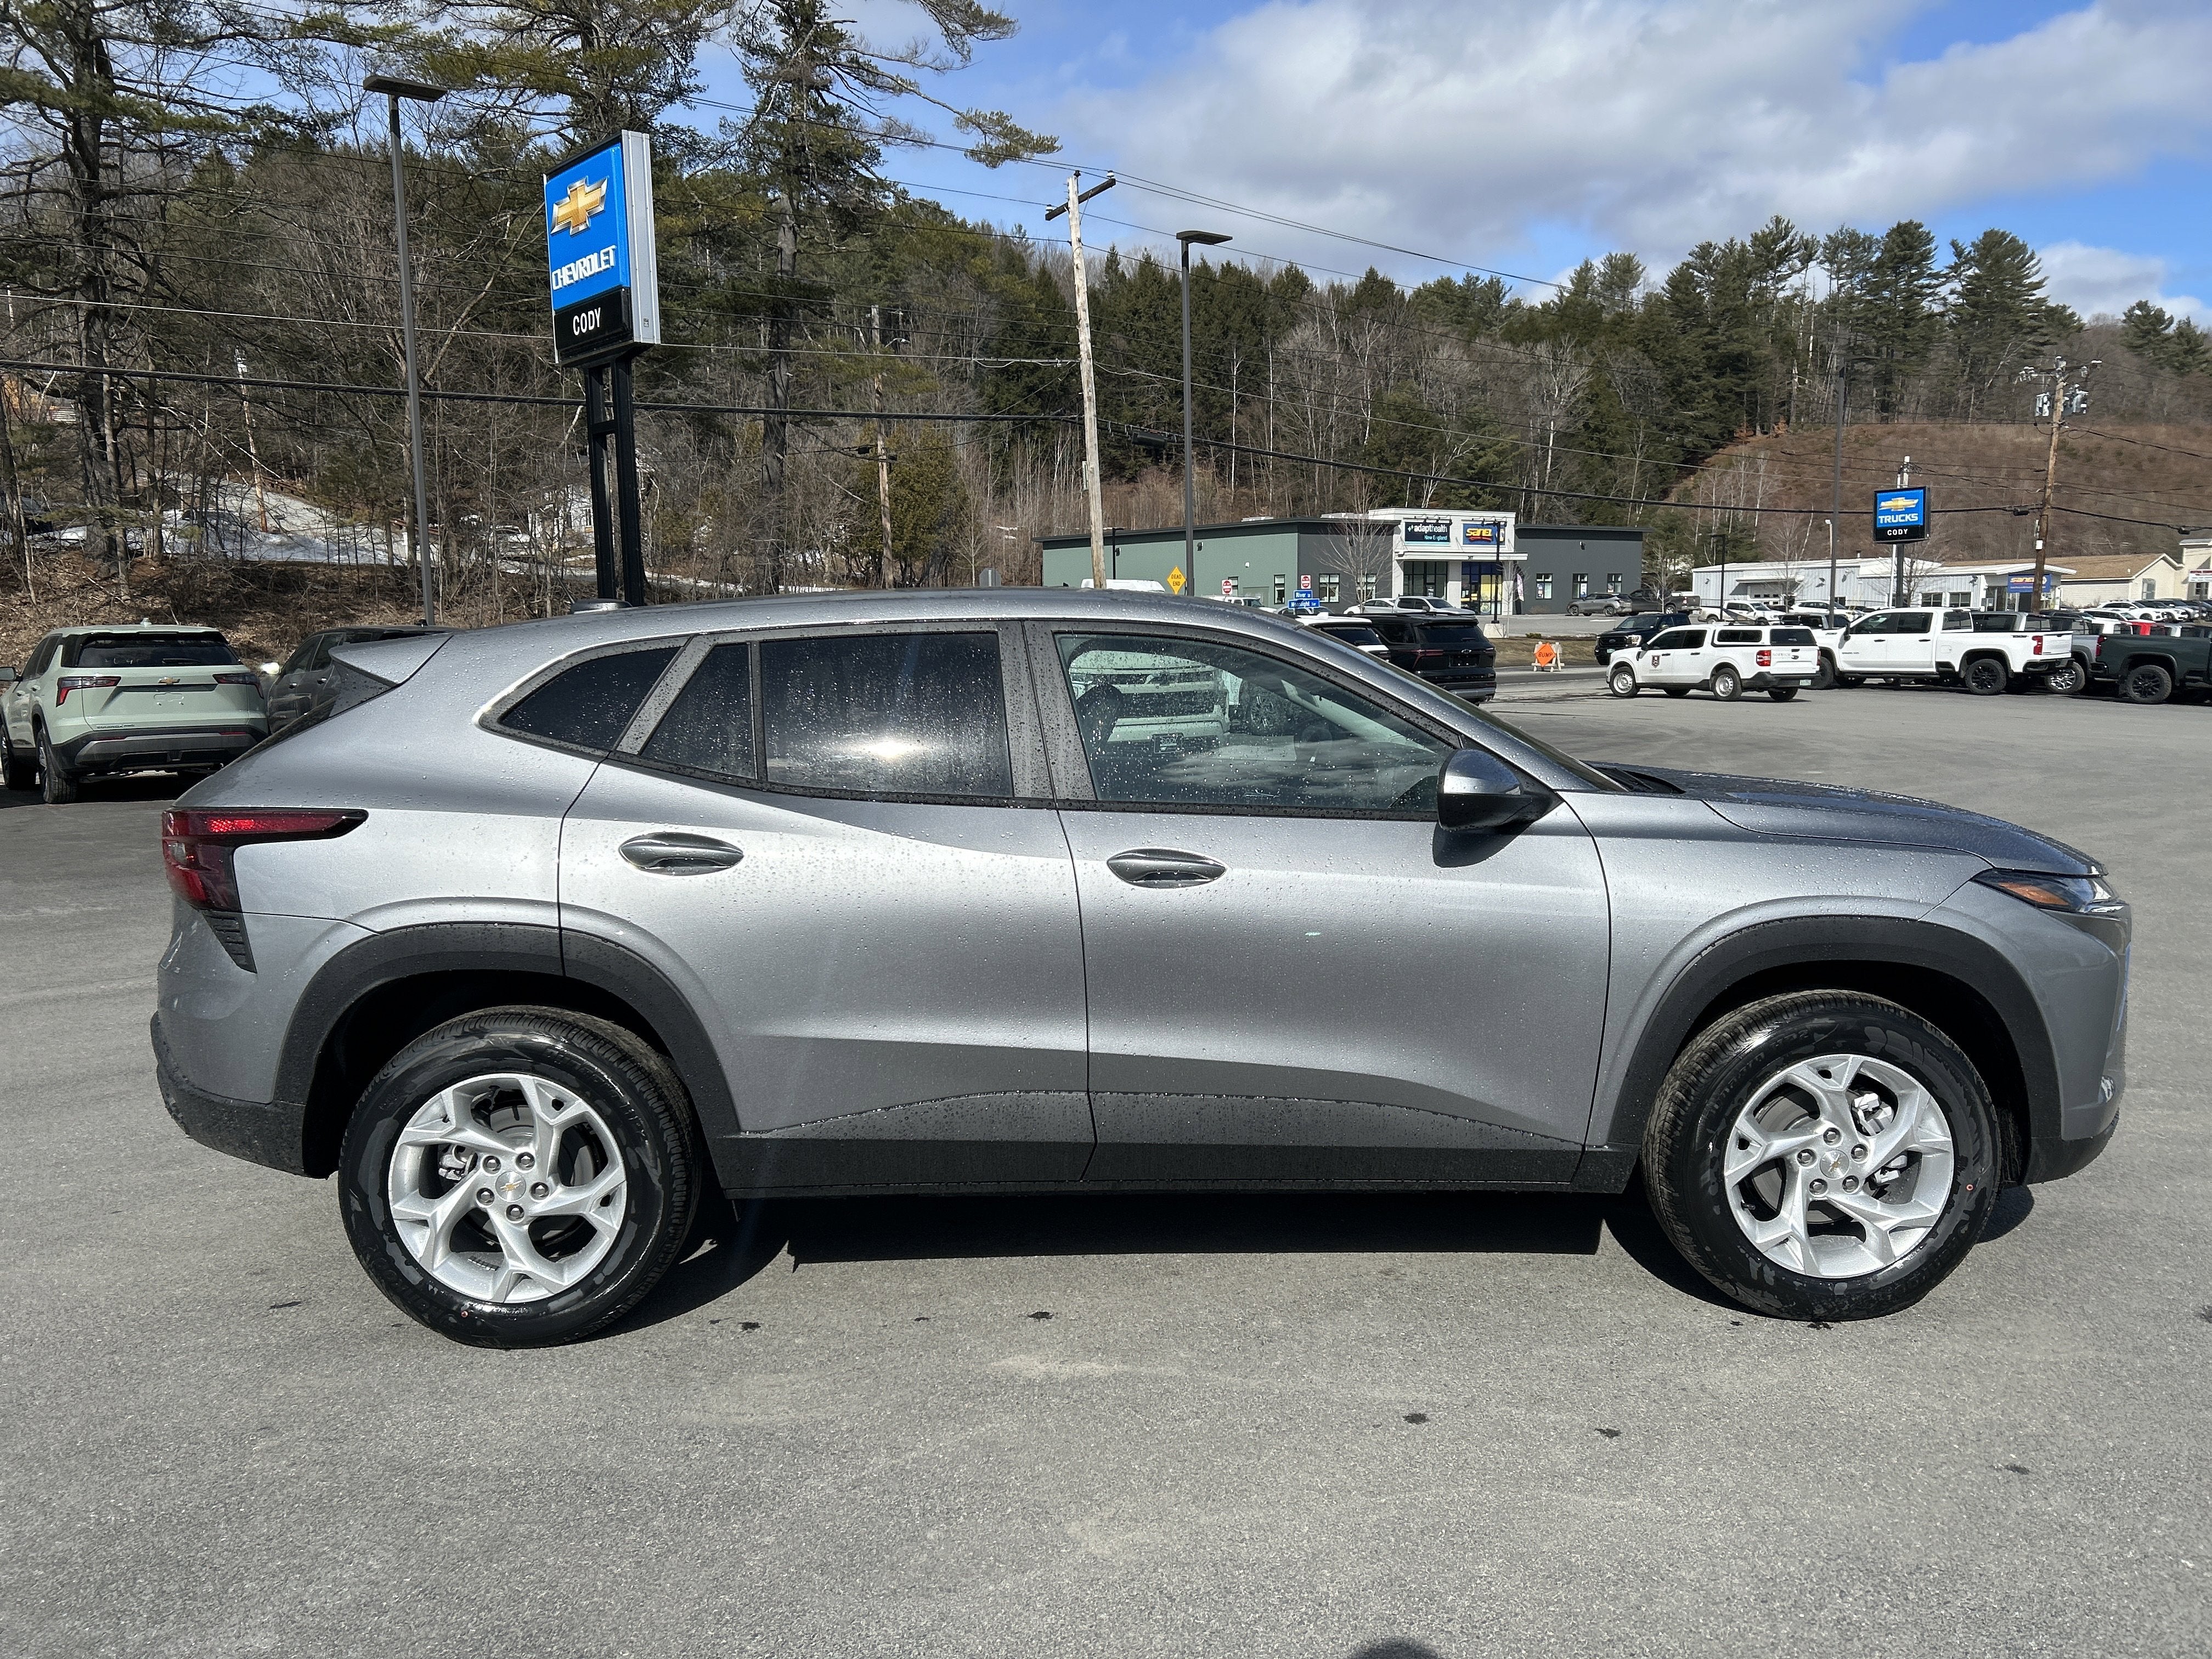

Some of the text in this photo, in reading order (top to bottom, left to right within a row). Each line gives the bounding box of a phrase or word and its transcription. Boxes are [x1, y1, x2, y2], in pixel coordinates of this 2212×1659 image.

[551, 245, 617, 291] CHEVROLET
[573, 307, 601, 336] CODY
[1878, 514, 1918, 524] TRUCKS
[1414, 524, 1447, 534] adapthealth
